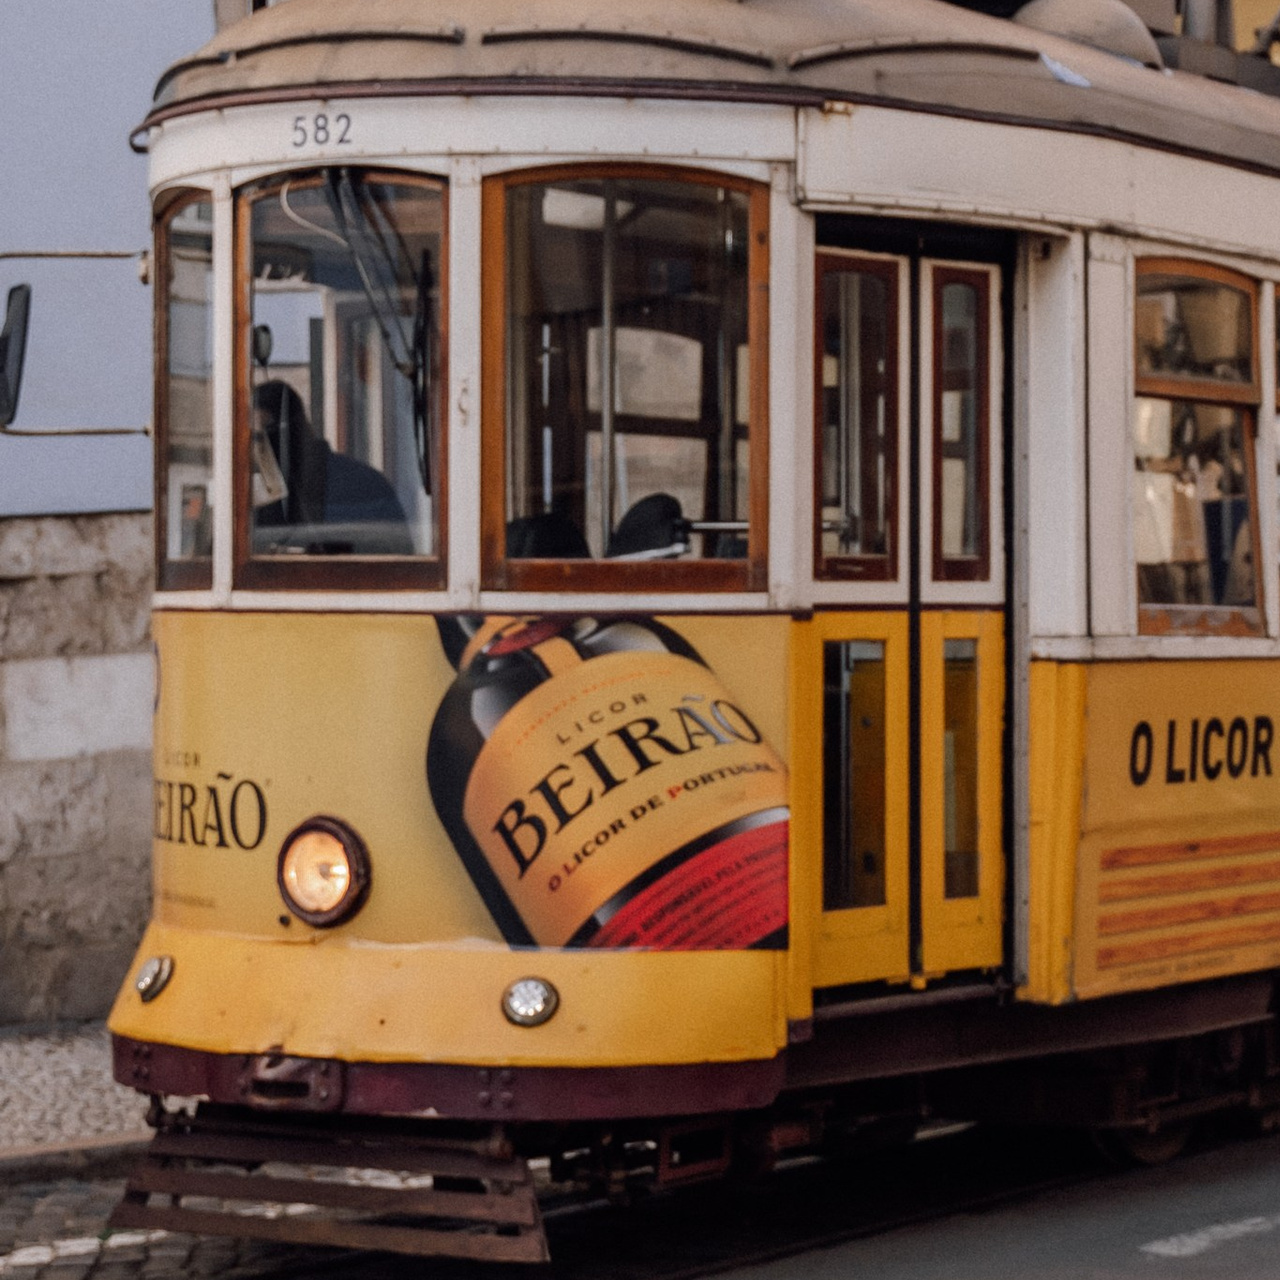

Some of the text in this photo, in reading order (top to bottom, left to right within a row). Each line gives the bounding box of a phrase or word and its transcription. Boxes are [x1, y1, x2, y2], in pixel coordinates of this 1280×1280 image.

[292, 113, 352, 148] 582
[555, 692, 647, 745] LICOR
[1129, 720, 1154, 786] O
[1165, 716, 1274, 784] LICOR
[491, 694, 763, 881] BEIRÃO
[548, 873, 563, 893] O
[562, 818, 627, 876] LICOR
[630, 795, 665, 821] DE
